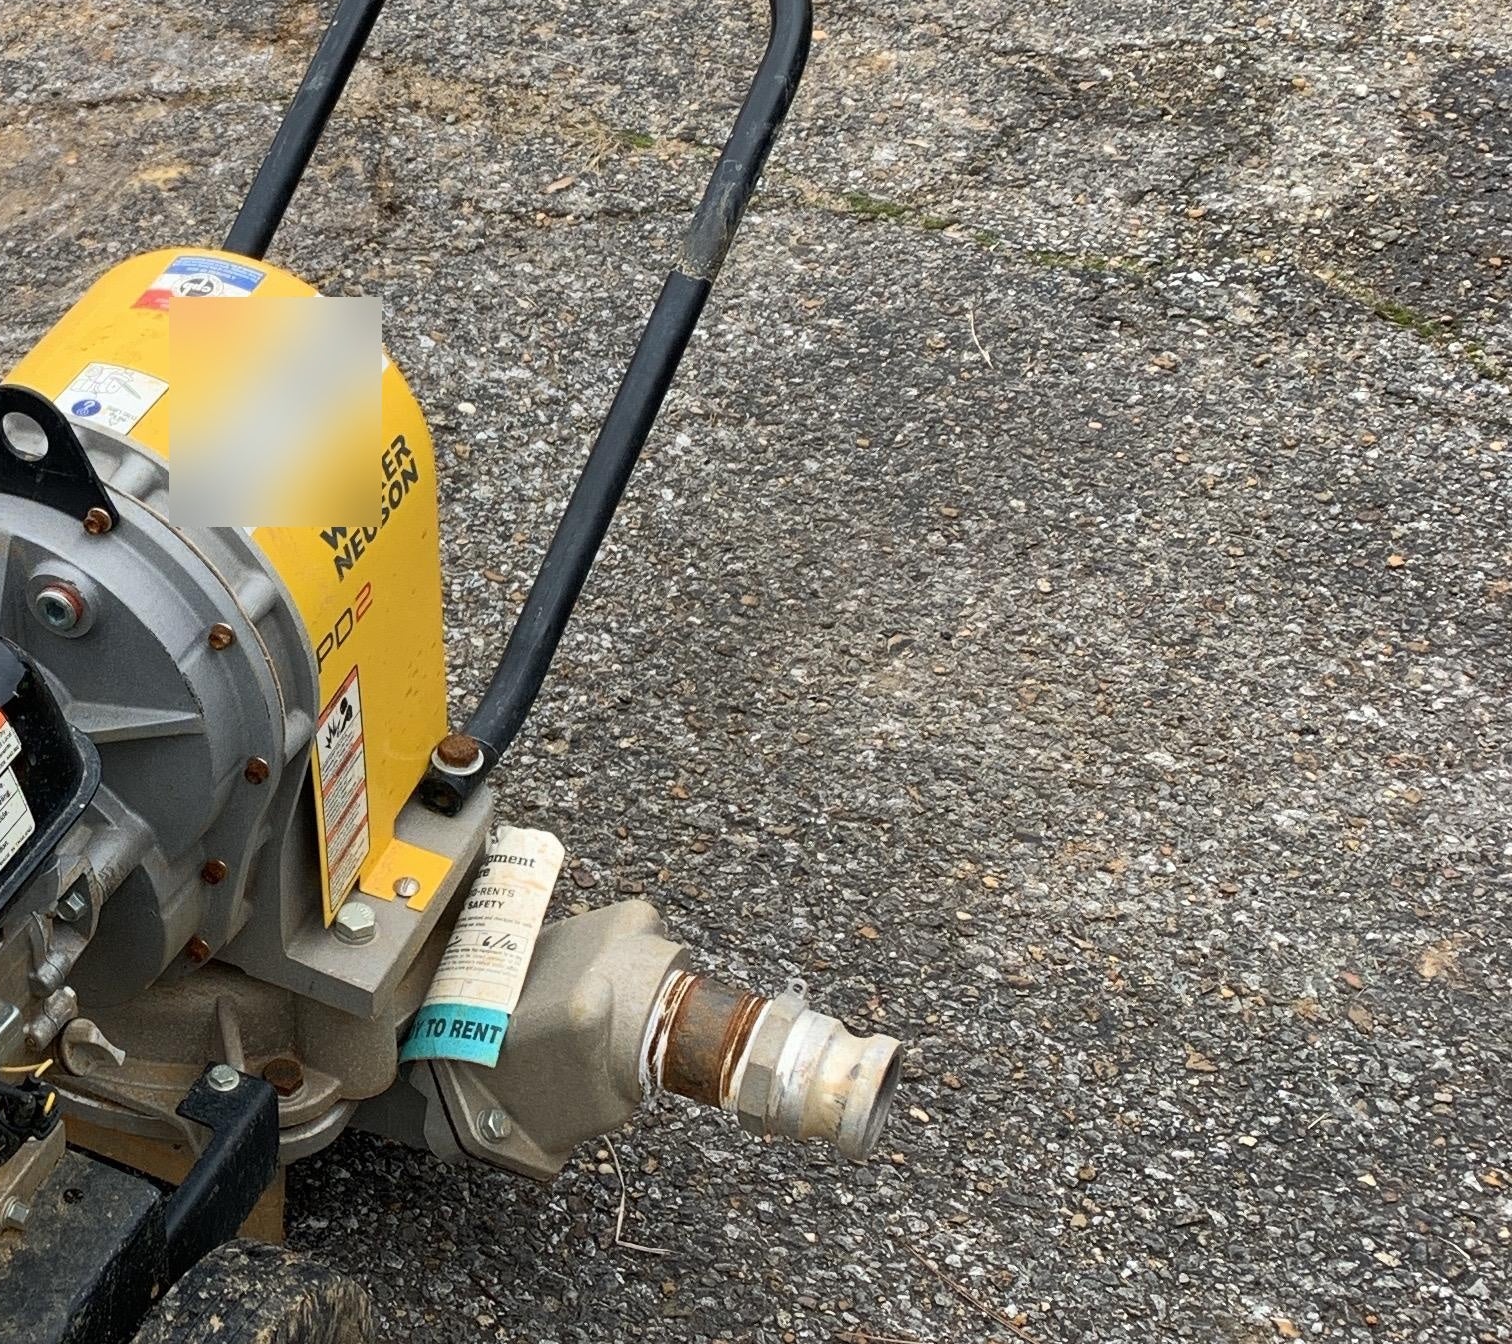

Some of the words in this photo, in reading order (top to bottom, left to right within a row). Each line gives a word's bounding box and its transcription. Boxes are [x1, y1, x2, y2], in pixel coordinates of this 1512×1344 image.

[316, 581, 373, 674] PD2
[468, 900, 505, 910] SAFETY
[425, 1017, 446, 1038] TO
[449, 1019, 502, 1044] RENT
